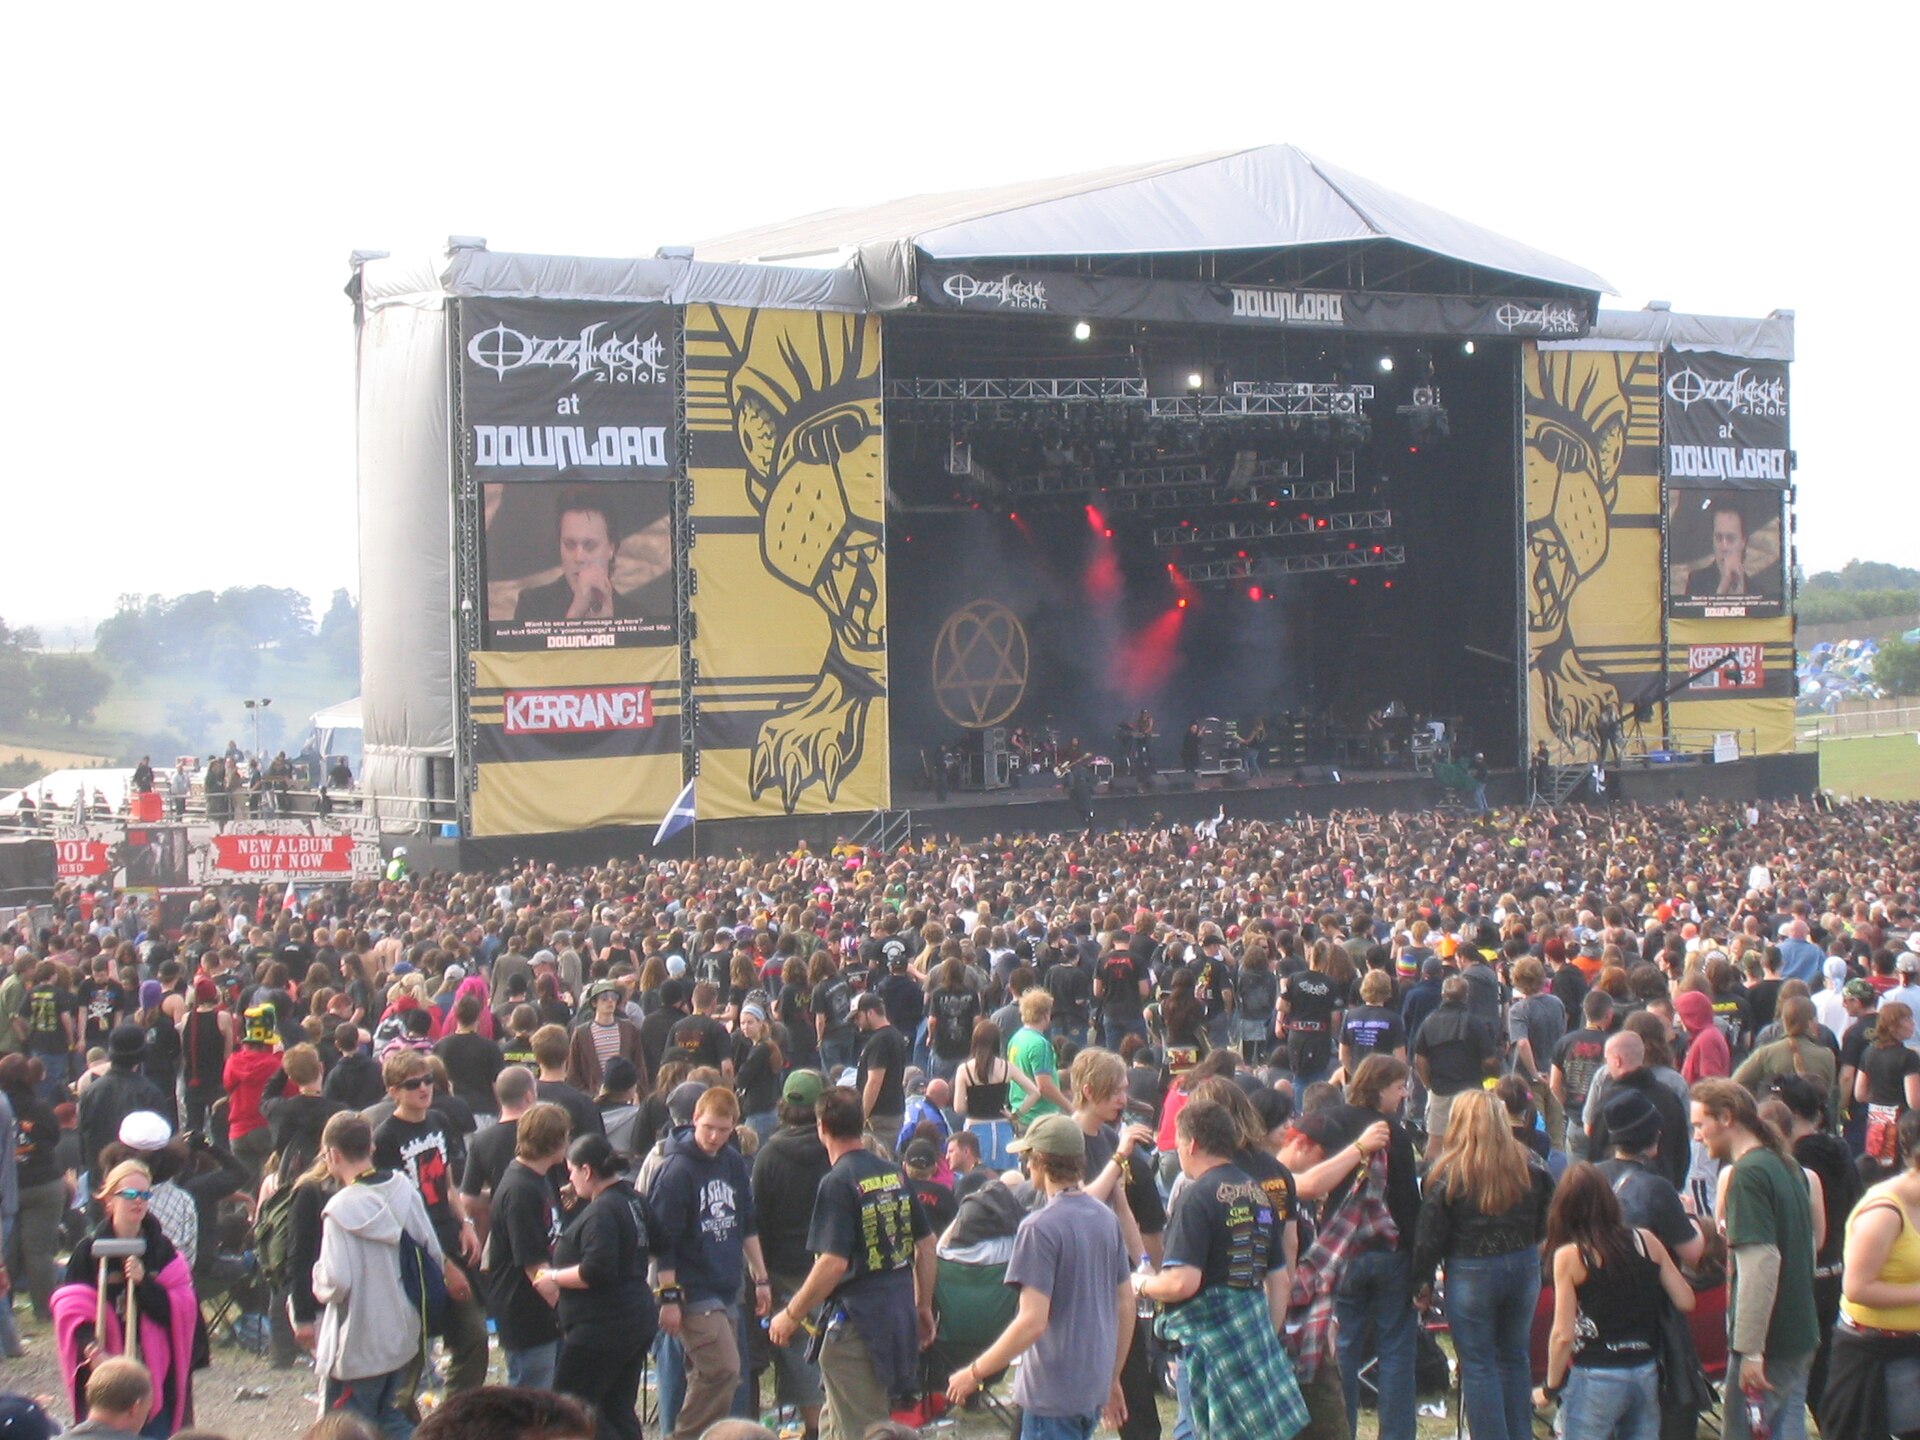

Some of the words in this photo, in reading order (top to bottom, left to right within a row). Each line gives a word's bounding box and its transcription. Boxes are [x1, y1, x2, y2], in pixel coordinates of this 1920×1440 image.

[943, 273, 1048, 307] Ozzfest
[1231, 288, 1344, 322] DOWNLOAD
[467, 321, 670, 384] Ozzfest
[594, 372, 667, 383] 2005
[1667, 366, 1788, 415] Ozzfest
[557, 393, 580, 415] at
[1741, 406, 1787, 416] 2005
[1718, 422, 1735, 439] at
[473, 425, 669, 471] DOWNLOAD
[1669, 445, 1787, 480] DOWNLOAD
[546, 634, 616, 649] DOWNLOAD
[505, 689, 646, 731] KERRANG!
[237, 839, 273, 853] NEW
[276, 838, 334, 853] ALBUM
[249, 855, 283, 869] OUT
[288, 853, 325, 868] NOW
